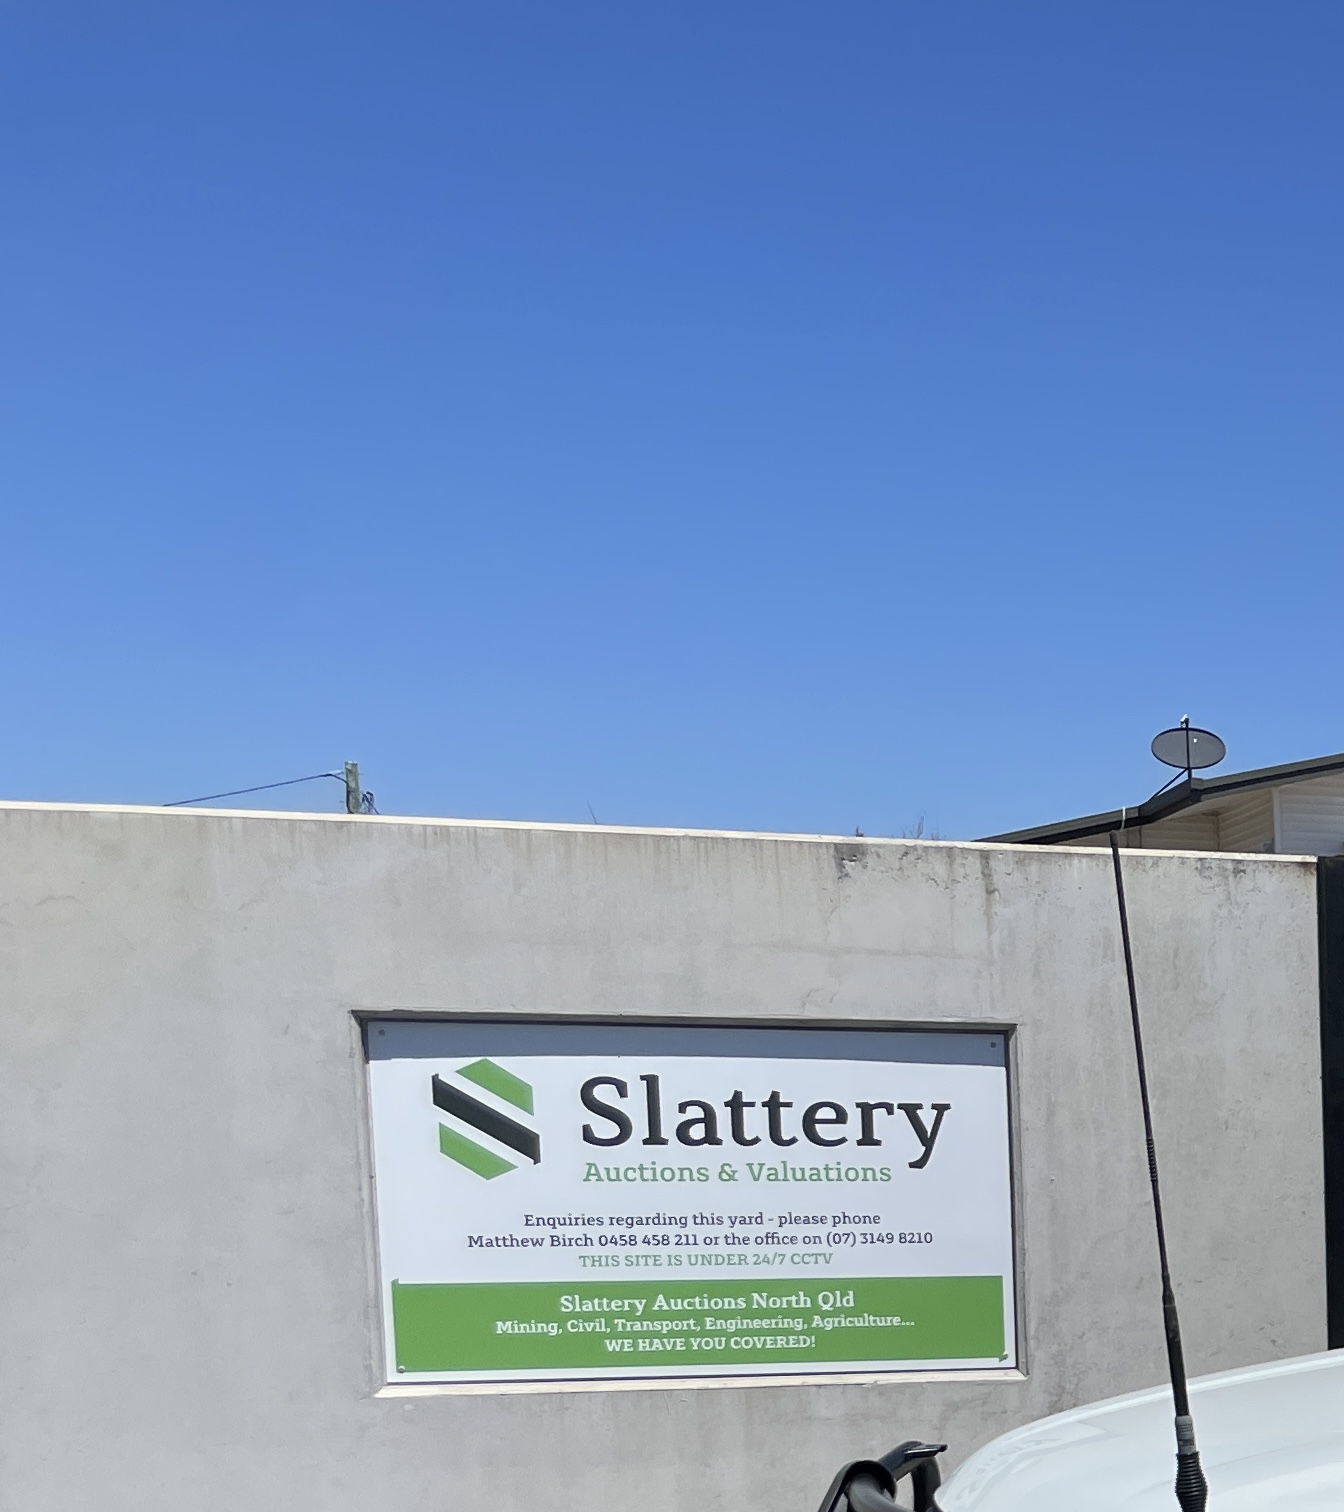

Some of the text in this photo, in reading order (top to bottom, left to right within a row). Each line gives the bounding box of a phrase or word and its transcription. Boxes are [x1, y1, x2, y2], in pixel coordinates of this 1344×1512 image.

[579, 1073, 952, 1169] Slattery
[583, 1160, 892, 1182] Auctions & Valuations
[524, 1213, 605, 1229] Enquiries
[608, 1212, 688, 1229] regarding
[692, 1212, 725, 1226] this
[728, 1212, 764, 1228] yard
[778, 1211, 828, 1227] please
[832, 1211, 881, 1227] phone
[467, 1231, 934, 1248] Matthew Birch 0458 458 211 or the office on (07) 3149 8210
[578, 1252, 834, 1267] THIS SITE IS UNDER 24/7 CCTV
[560, 1290, 855, 1315] Slattery Auctions North Qld
[496, 1313, 915, 1336] Mining, Civil, Transport, Engineering, Agriculture...
[604, 1335, 816, 1352] WE HAVE YOU COVERED!
